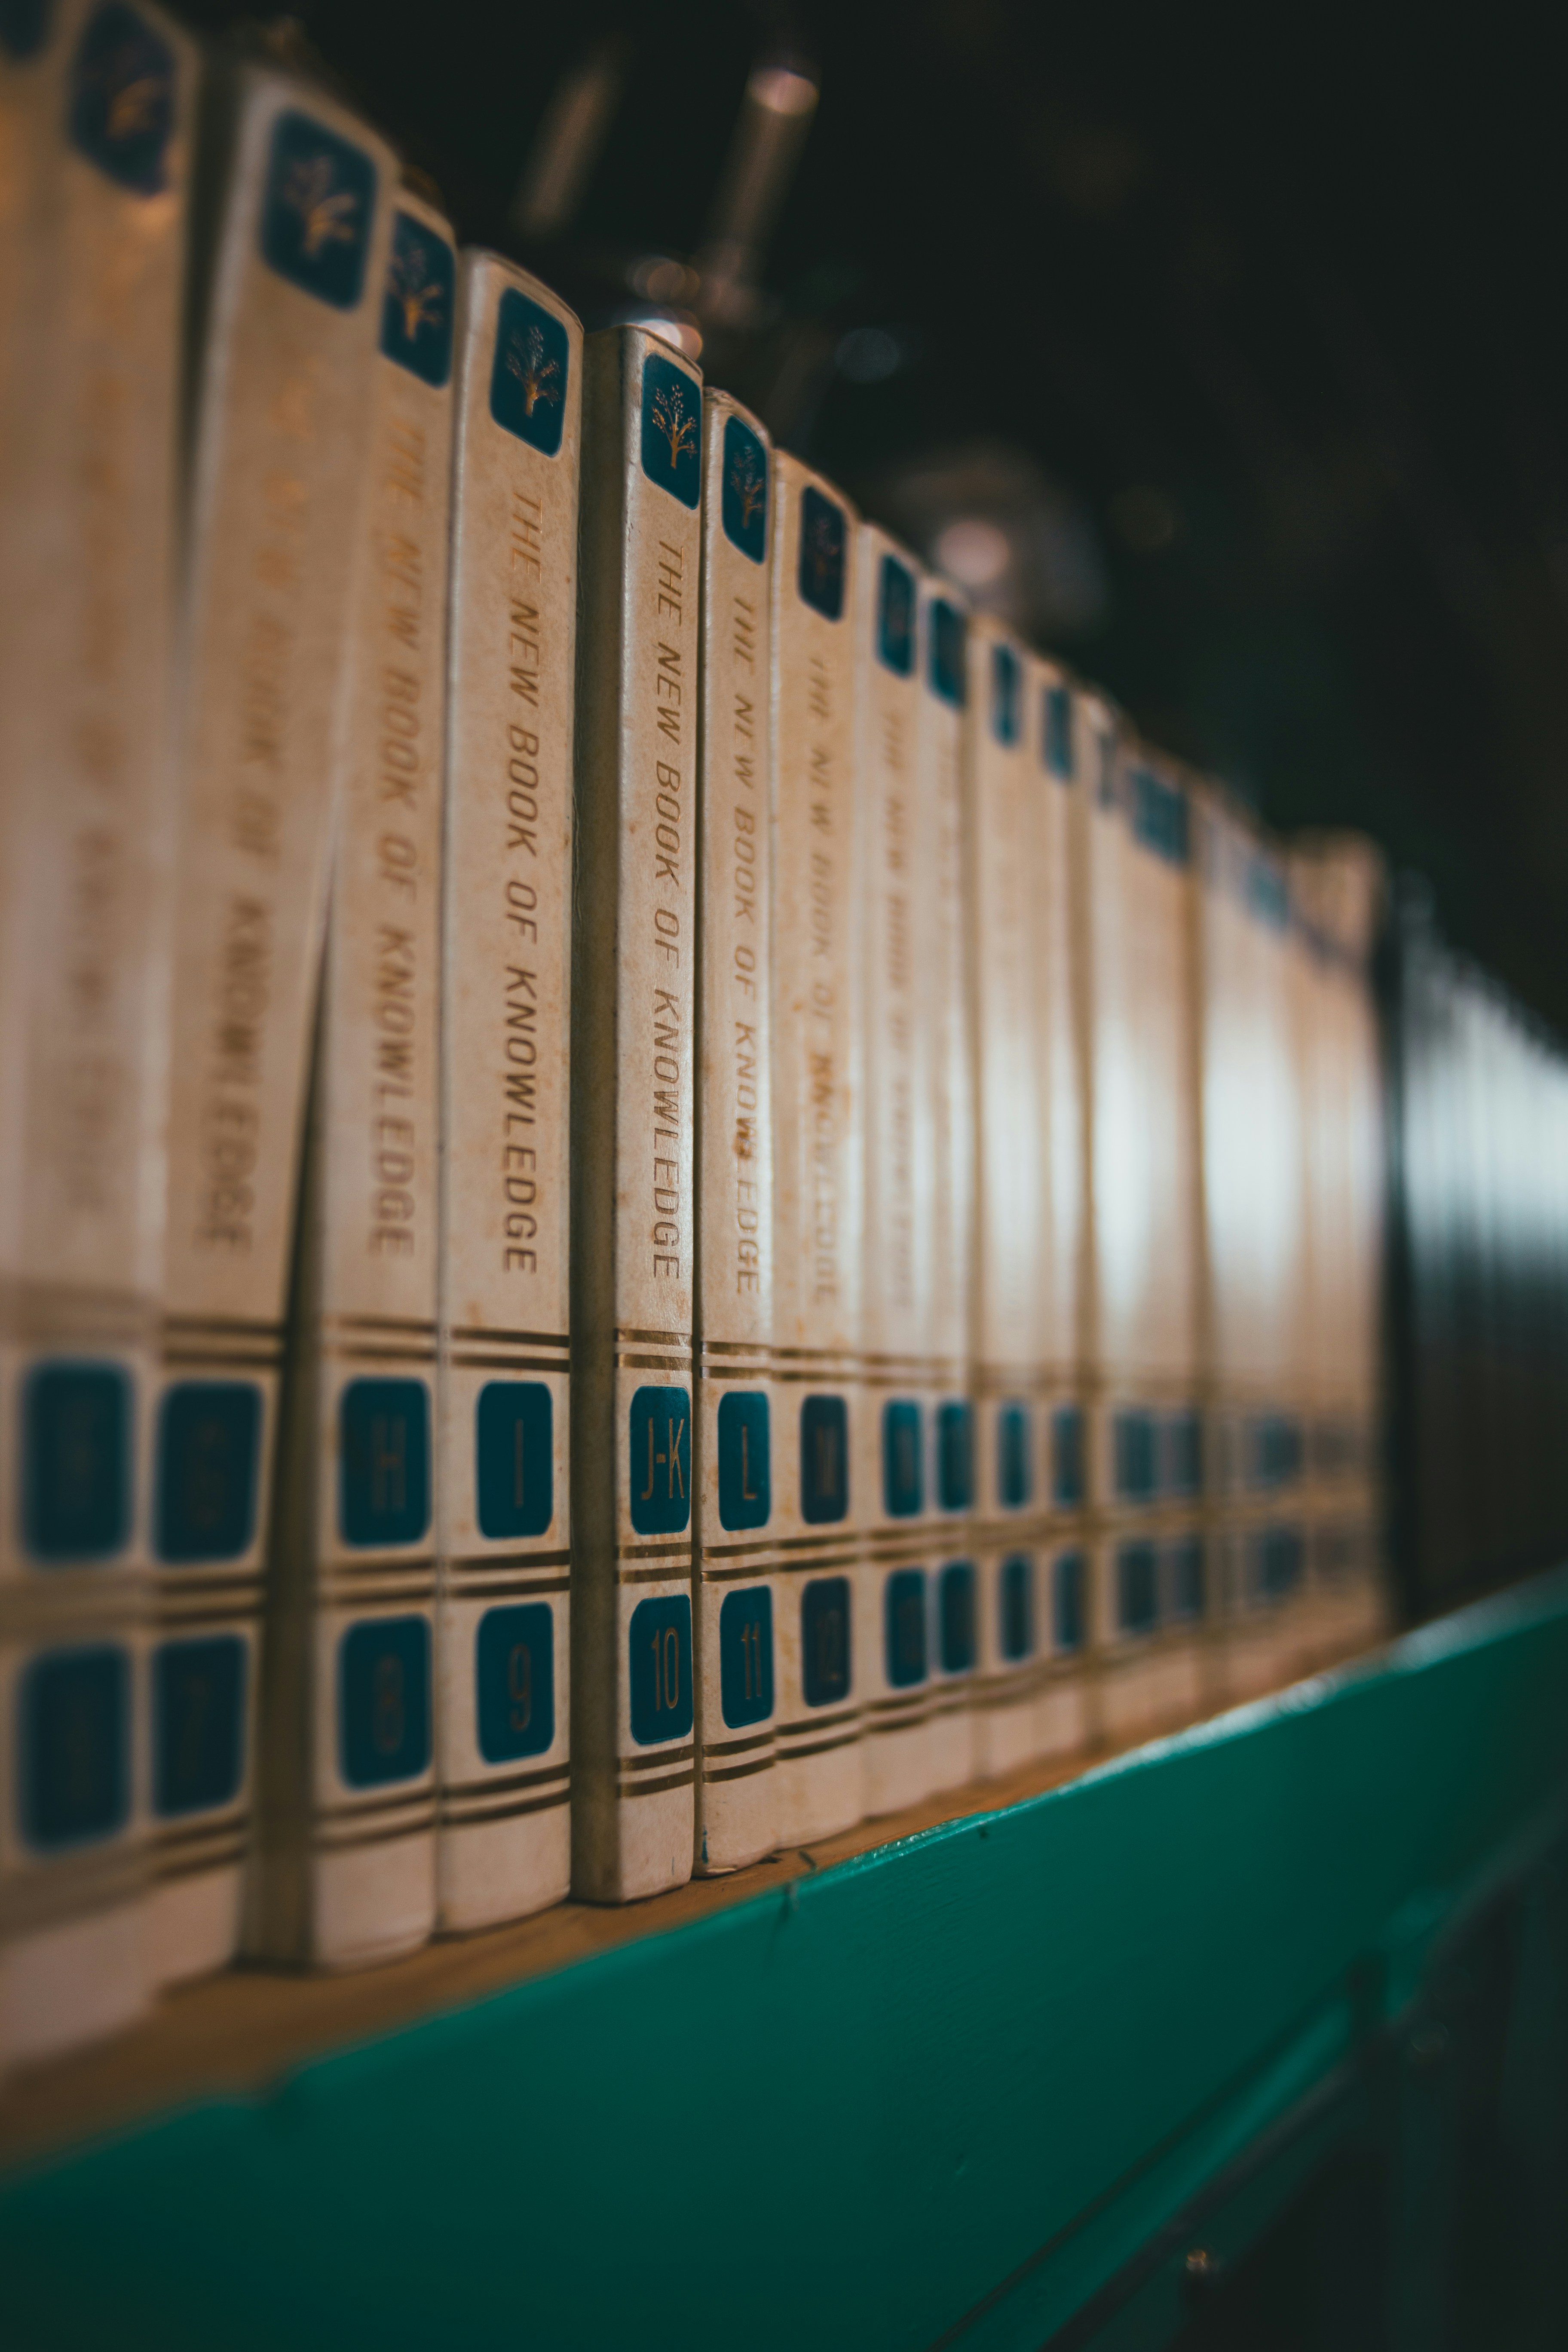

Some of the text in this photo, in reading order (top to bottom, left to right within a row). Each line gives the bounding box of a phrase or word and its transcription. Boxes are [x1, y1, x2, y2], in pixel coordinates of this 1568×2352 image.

[381, 668, 420, 810] BOOK
[377, 833, 416, 903] OF
[502, 492, 542, 1274] THE NEW BOOK OF KNOWLEDGE
[653, 541, 683, 1279] THE NEW BOOK OF KNOWLEDGE
[733, 597, 761, 1295] THE NEW BOOK OF KNOWLEDGE
[369, 923, 415, 1256] KNOWLEDGE
[371, 1412, 405, 1517] H
[640, 1417, 685, 1500] J-K
[742, 1425, 757, 1500] L
[508, 1644, 531, 1732] 9
[650, 1627, 679, 1712] 10
[741, 1622, 762, 1700] 11
